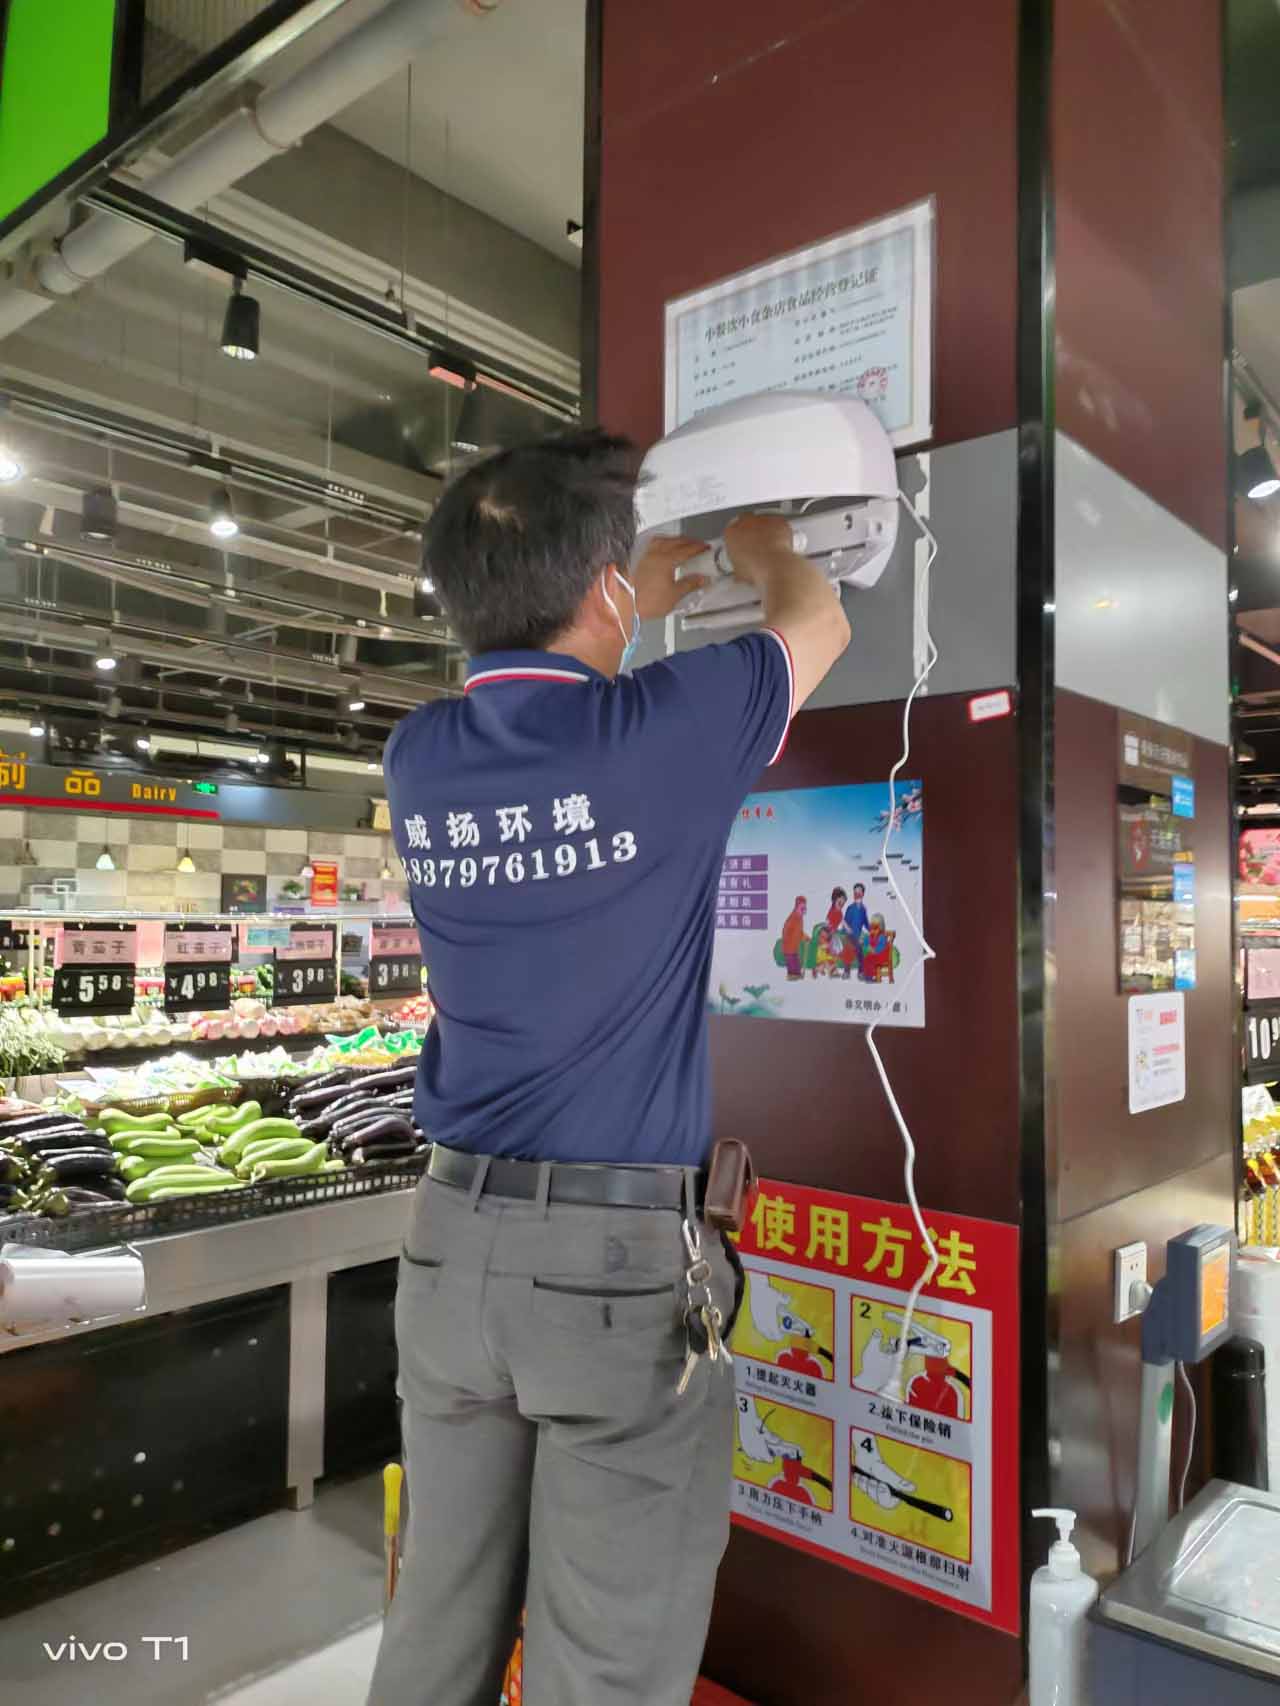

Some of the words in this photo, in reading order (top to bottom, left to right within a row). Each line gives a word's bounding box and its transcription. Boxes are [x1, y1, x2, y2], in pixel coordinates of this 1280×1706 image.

[404, 793, 595, 850] 威扬环境
[727, 1193, 977, 1296] 使用方法
[860, 1302, 872, 1319] 2
[739, 1397, 749, 1413] 3
[860, 1437, 874, 1454] 4
